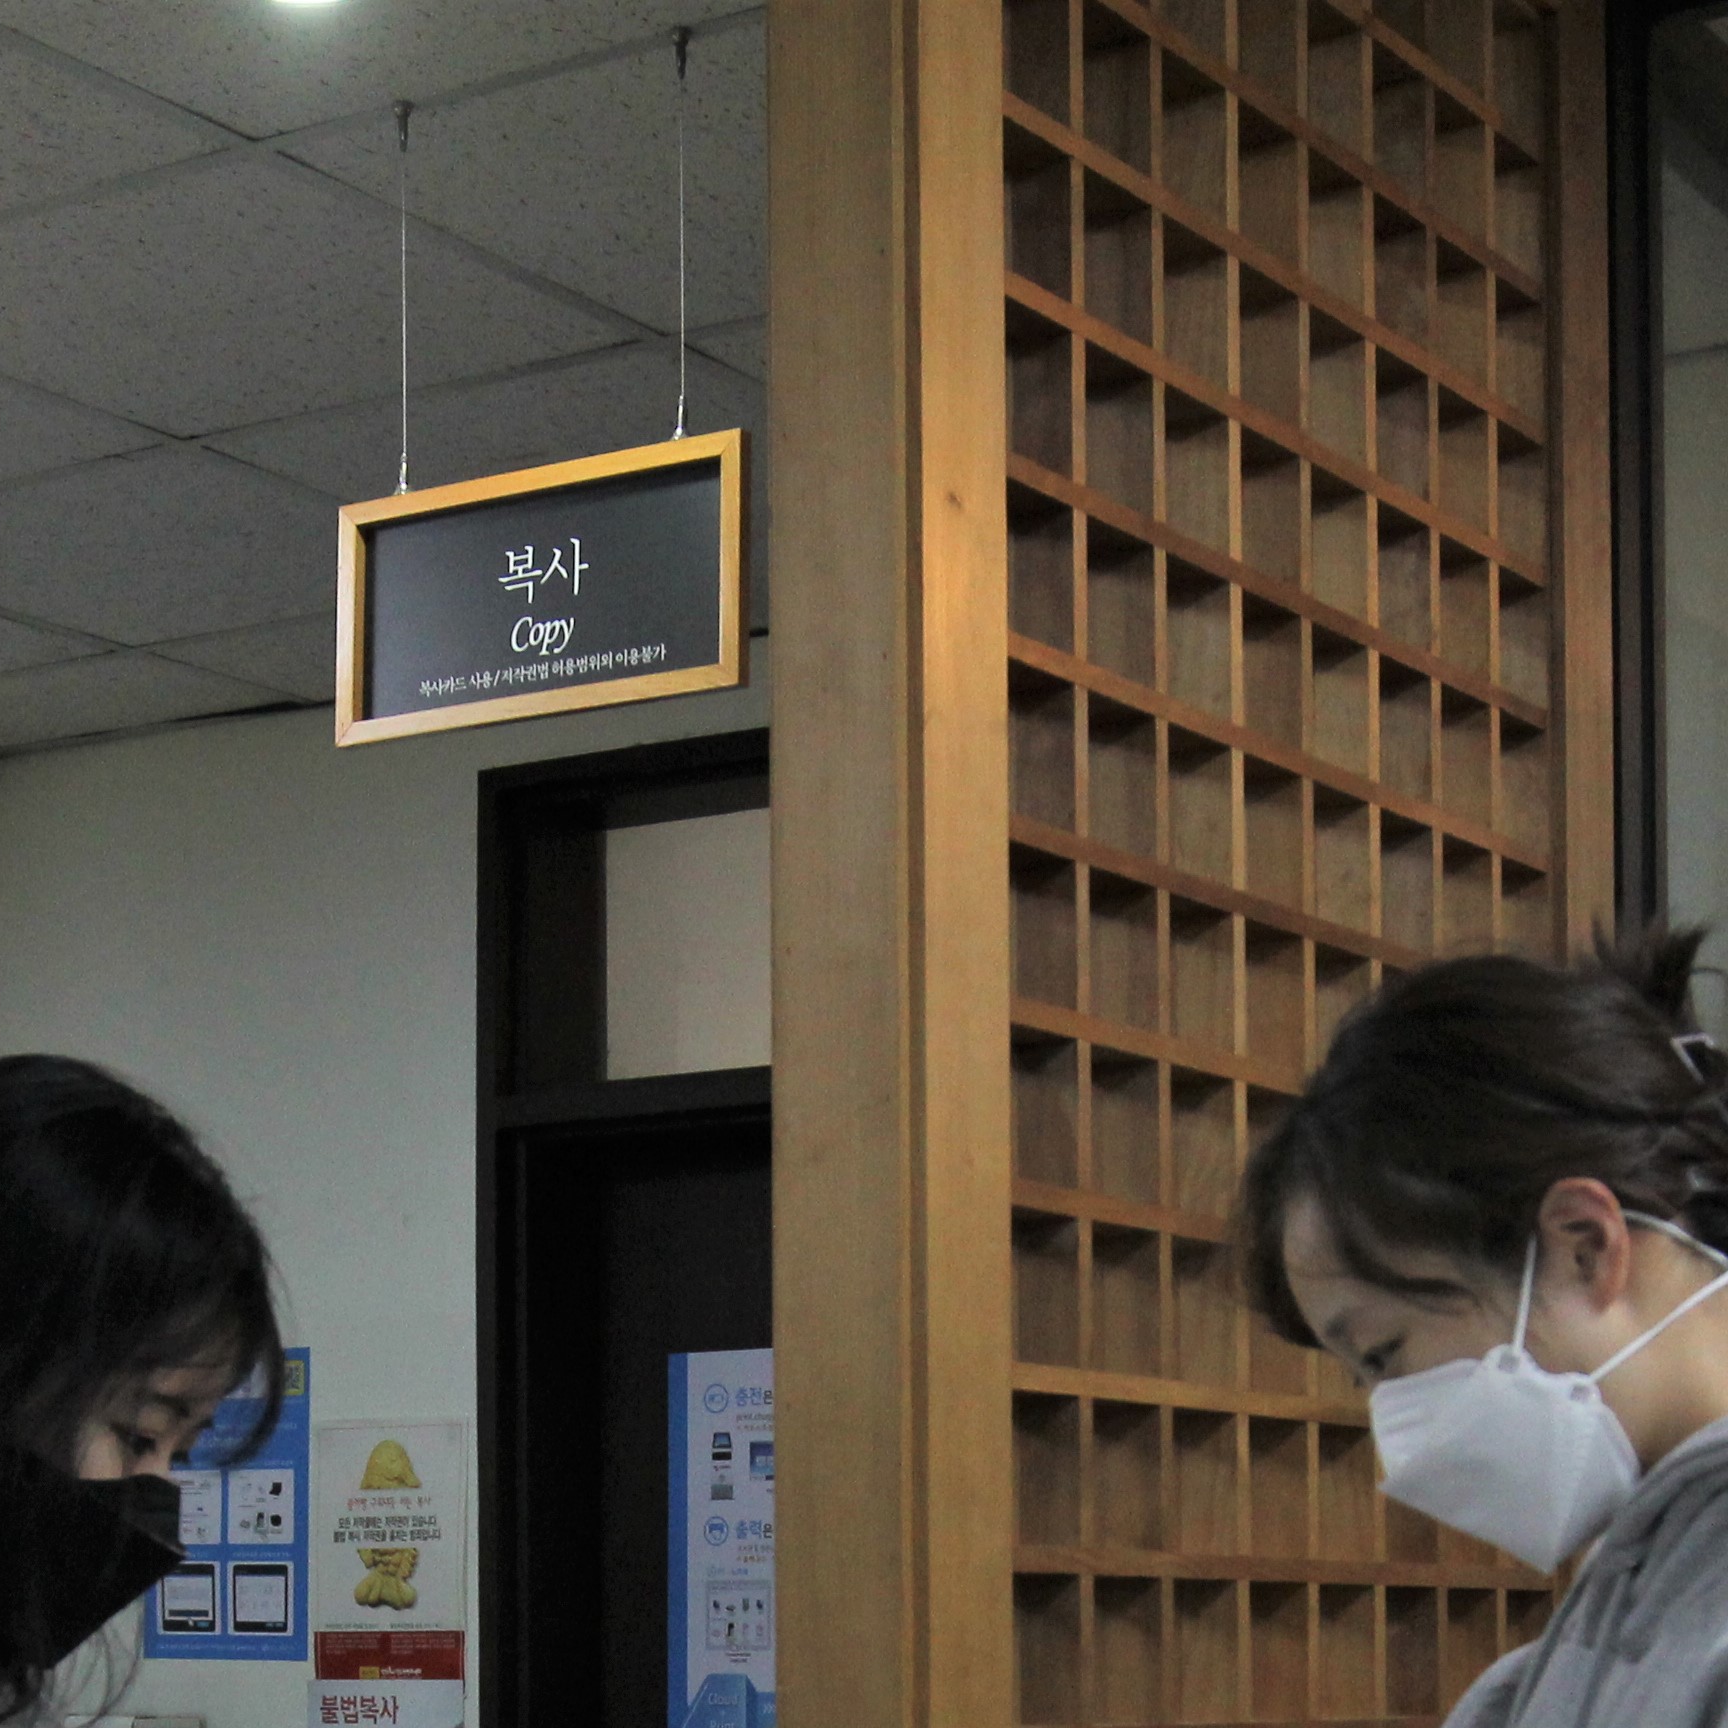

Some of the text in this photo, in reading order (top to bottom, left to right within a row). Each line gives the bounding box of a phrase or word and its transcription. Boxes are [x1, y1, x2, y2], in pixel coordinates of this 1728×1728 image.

[497, 537, 590, 604] 복사
[510, 616, 574, 656] Copy
[419, 675, 467, 698] 복사카드
[615, 643, 667, 668] 이용불가
[320, 1695, 399, 1725] 불법복사
